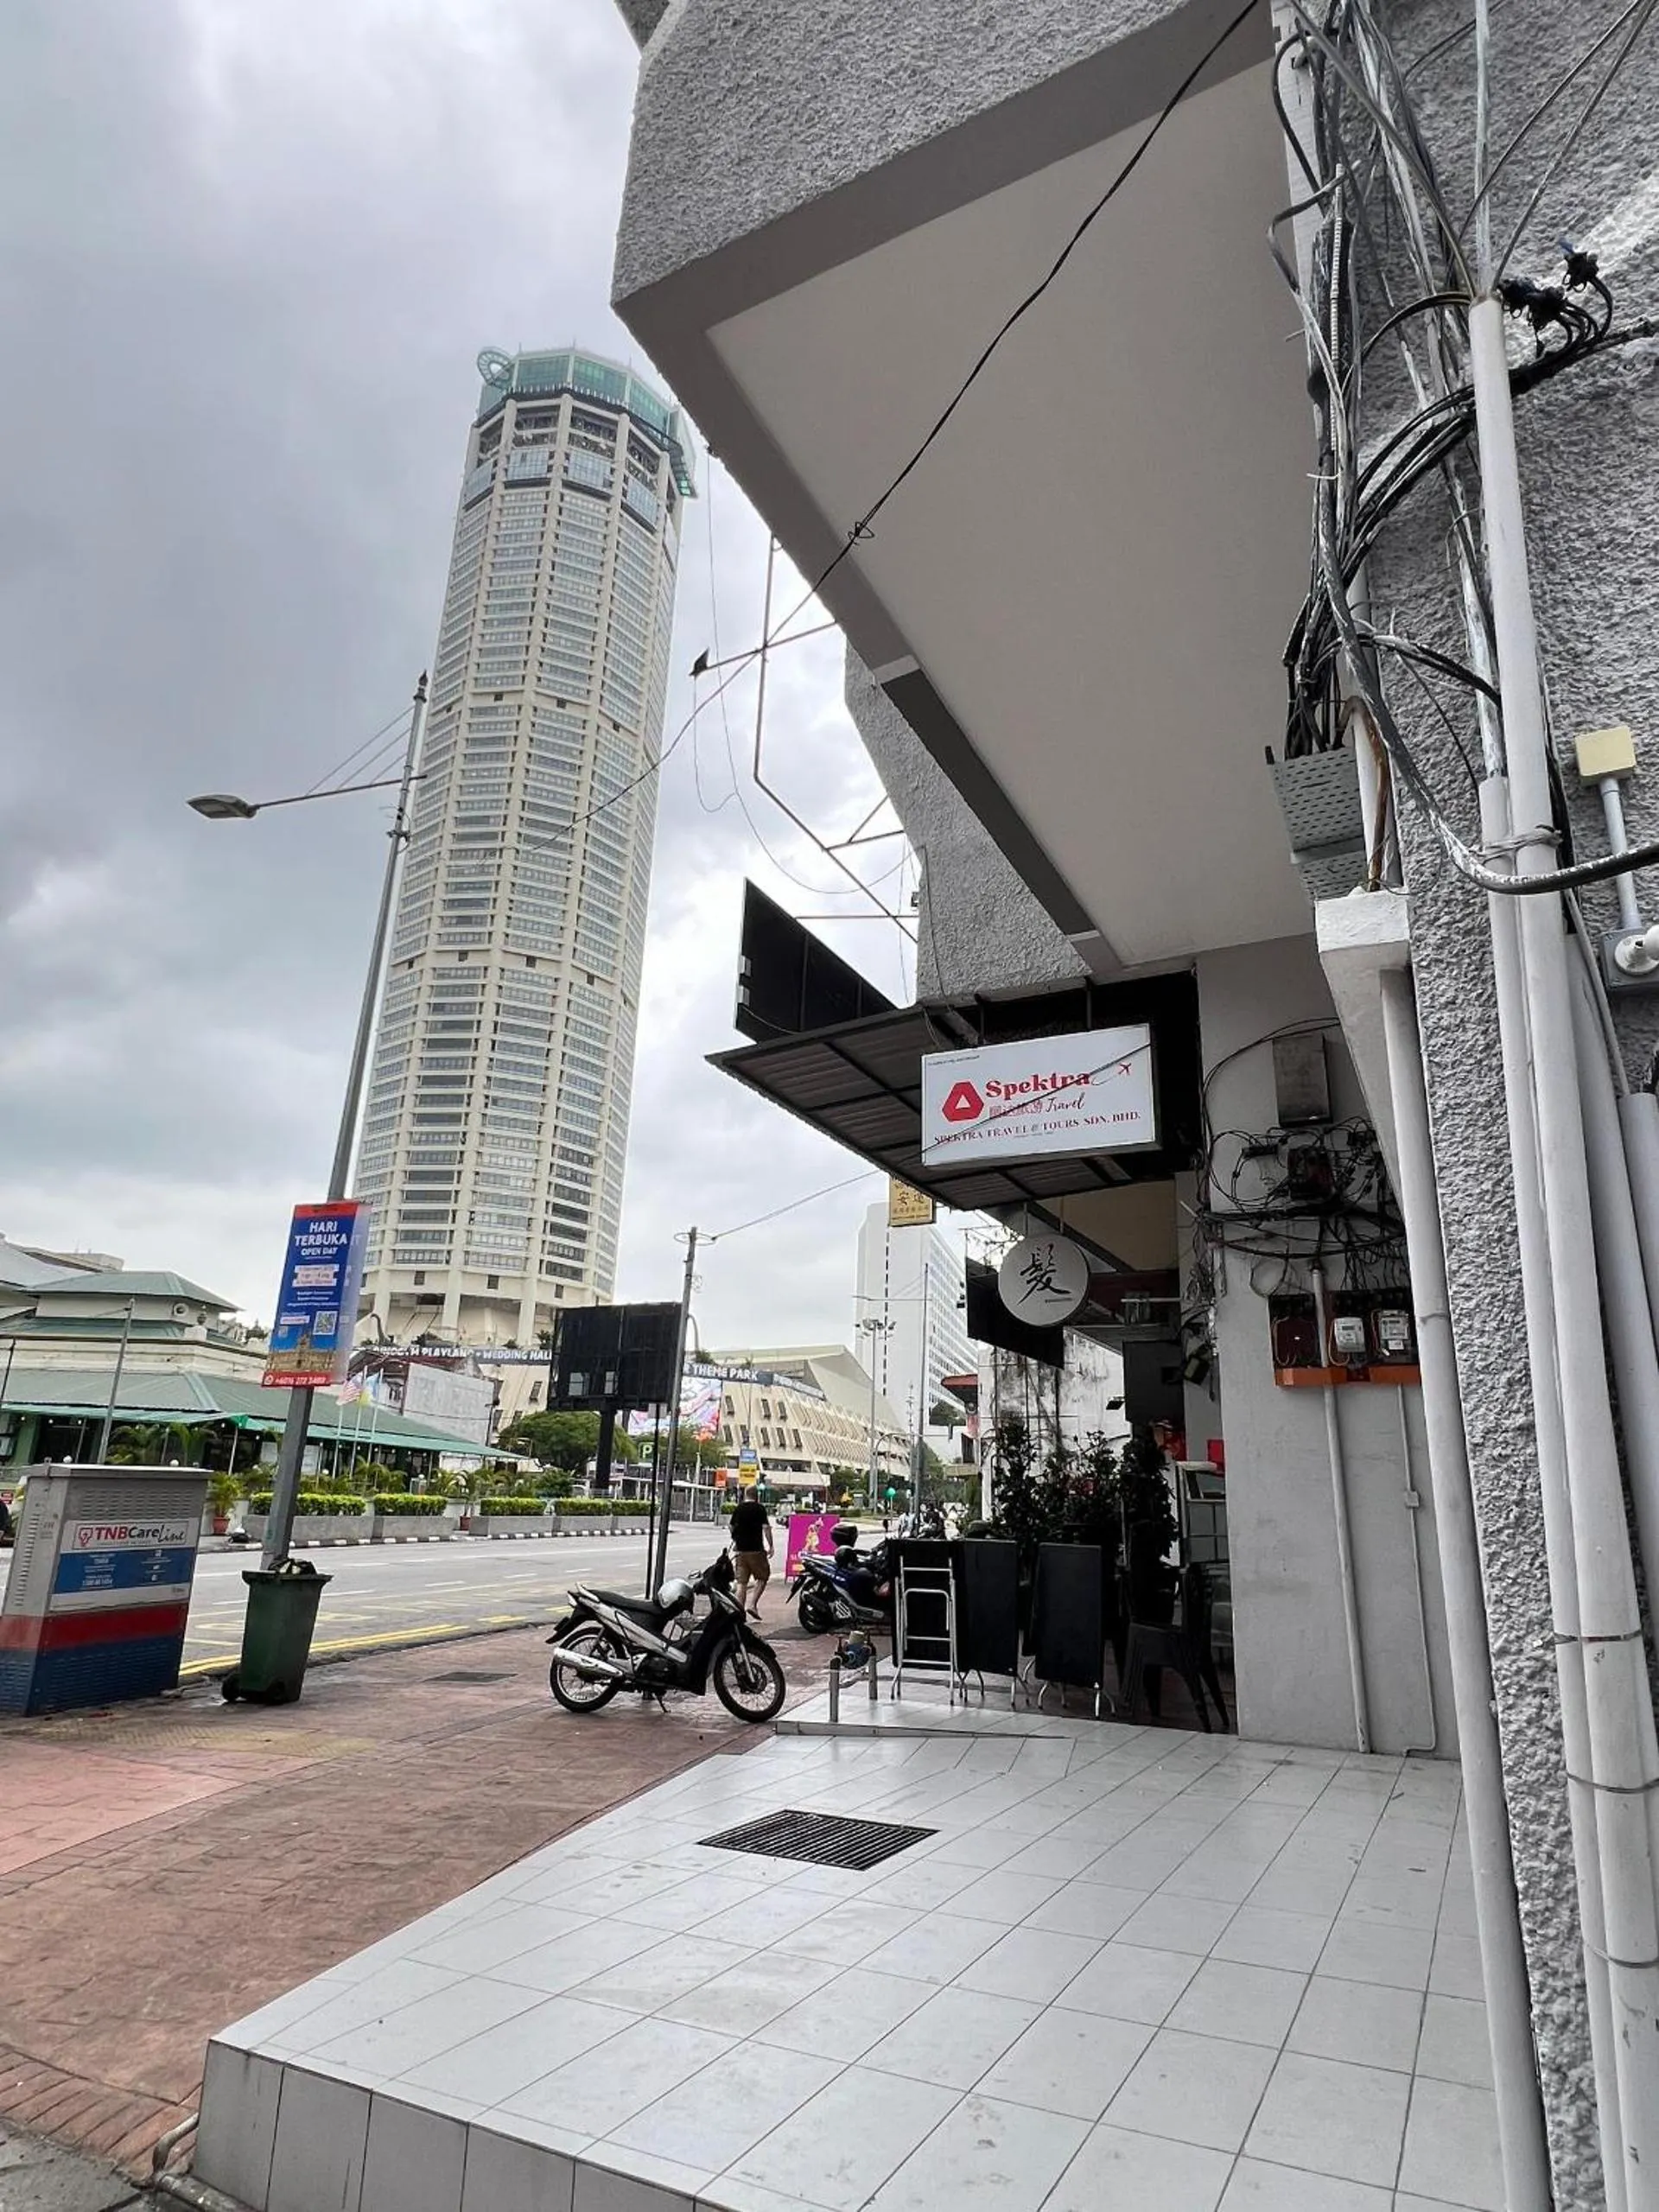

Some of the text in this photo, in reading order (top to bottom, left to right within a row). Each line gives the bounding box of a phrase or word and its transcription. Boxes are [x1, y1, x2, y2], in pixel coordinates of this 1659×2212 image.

[986, 1072, 1090, 1100] Spektra
[1046, 1092, 1085, 1113] Travel
[987, 1124, 1027, 1138] TRAVEL
[1043, 1118, 1079, 1130] TOURS
[1084, 1115, 1110, 1126] SDN.
[1113, 1110, 1141, 1122] BHD.
[309, 1220, 338, 1233] HARI
[294, 1233, 348, 1247] TERBUKA
[483, 1349, 528, 1360] WEDDING
[694, 1364, 728, 1378] THEME
[729, 1367, 760, 1381] PARK
[642, 1444, 652, 1459] P
